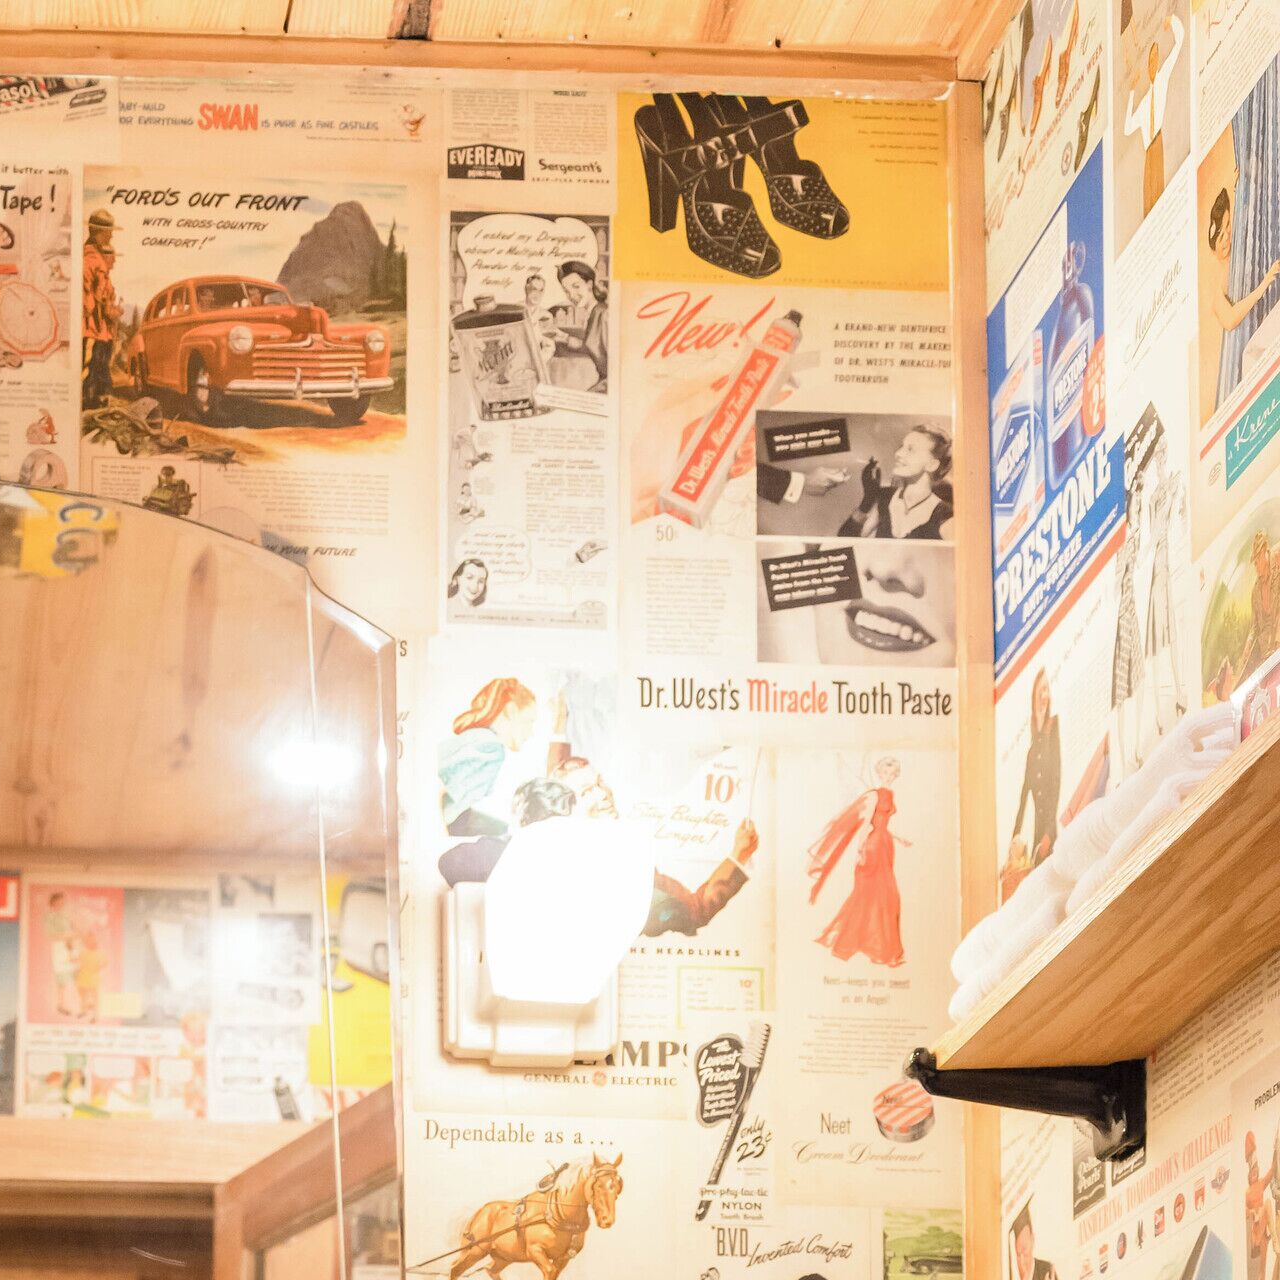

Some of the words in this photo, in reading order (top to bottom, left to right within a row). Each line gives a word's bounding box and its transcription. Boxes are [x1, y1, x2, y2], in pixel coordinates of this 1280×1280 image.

[197, 103, 259, 131] SWAN
[449, 146, 524, 166] EVEREADY
[13, 164, 44, 175] better
[48, 164, 70, 176] with
[538, 158, 602, 175] Sergeant's
[188, 193, 230, 208] OUT
[235, 195, 308, 211] FRONT
[141, 217, 172, 227] WITH
[176, 218, 269, 232] CROSS-COUNTRY
[834, 340, 880, 349] DISCOVERY
[885, 341, 895, 349] BY
[900, 342, 914, 350] THE
[834, 374, 889, 384] TOOTHBRUSH
[993, 441, 1112, 633] PRESTONE
[313, 547, 359, 557] FUTURE
[637, 677, 668, 709] Dr.
[672, 677, 740, 711] West's
[747, 678, 829, 714] Miracle
[833, 681, 892, 714] Tooth
[898, 682, 953, 716] Paste
[656, 947, 742, 957] HEADLINES
[889, 979, 911, 989] sweet
[523, 1073, 589, 1085] GENERAL
[611, 1076, 678, 1086] ELECTRIC
[699, 1063, 742, 1086] Priced
[740, 1115, 766, 1139] only
[820, 1112, 852, 1135] Neet
[424, 1119, 535, 1149] Dependable
[544, 1130, 565, 1144] as
[1182, 1113, 1233, 1173] CHALLENGE
[791, 1140, 845, 1164] Cream
[848, 1143, 926, 1165] Deodorant
[721, 1202, 762, 1211] NYLON
[746, 1236, 807, 1268] Invented
[807, 1233, 853, 1263] Comfort
